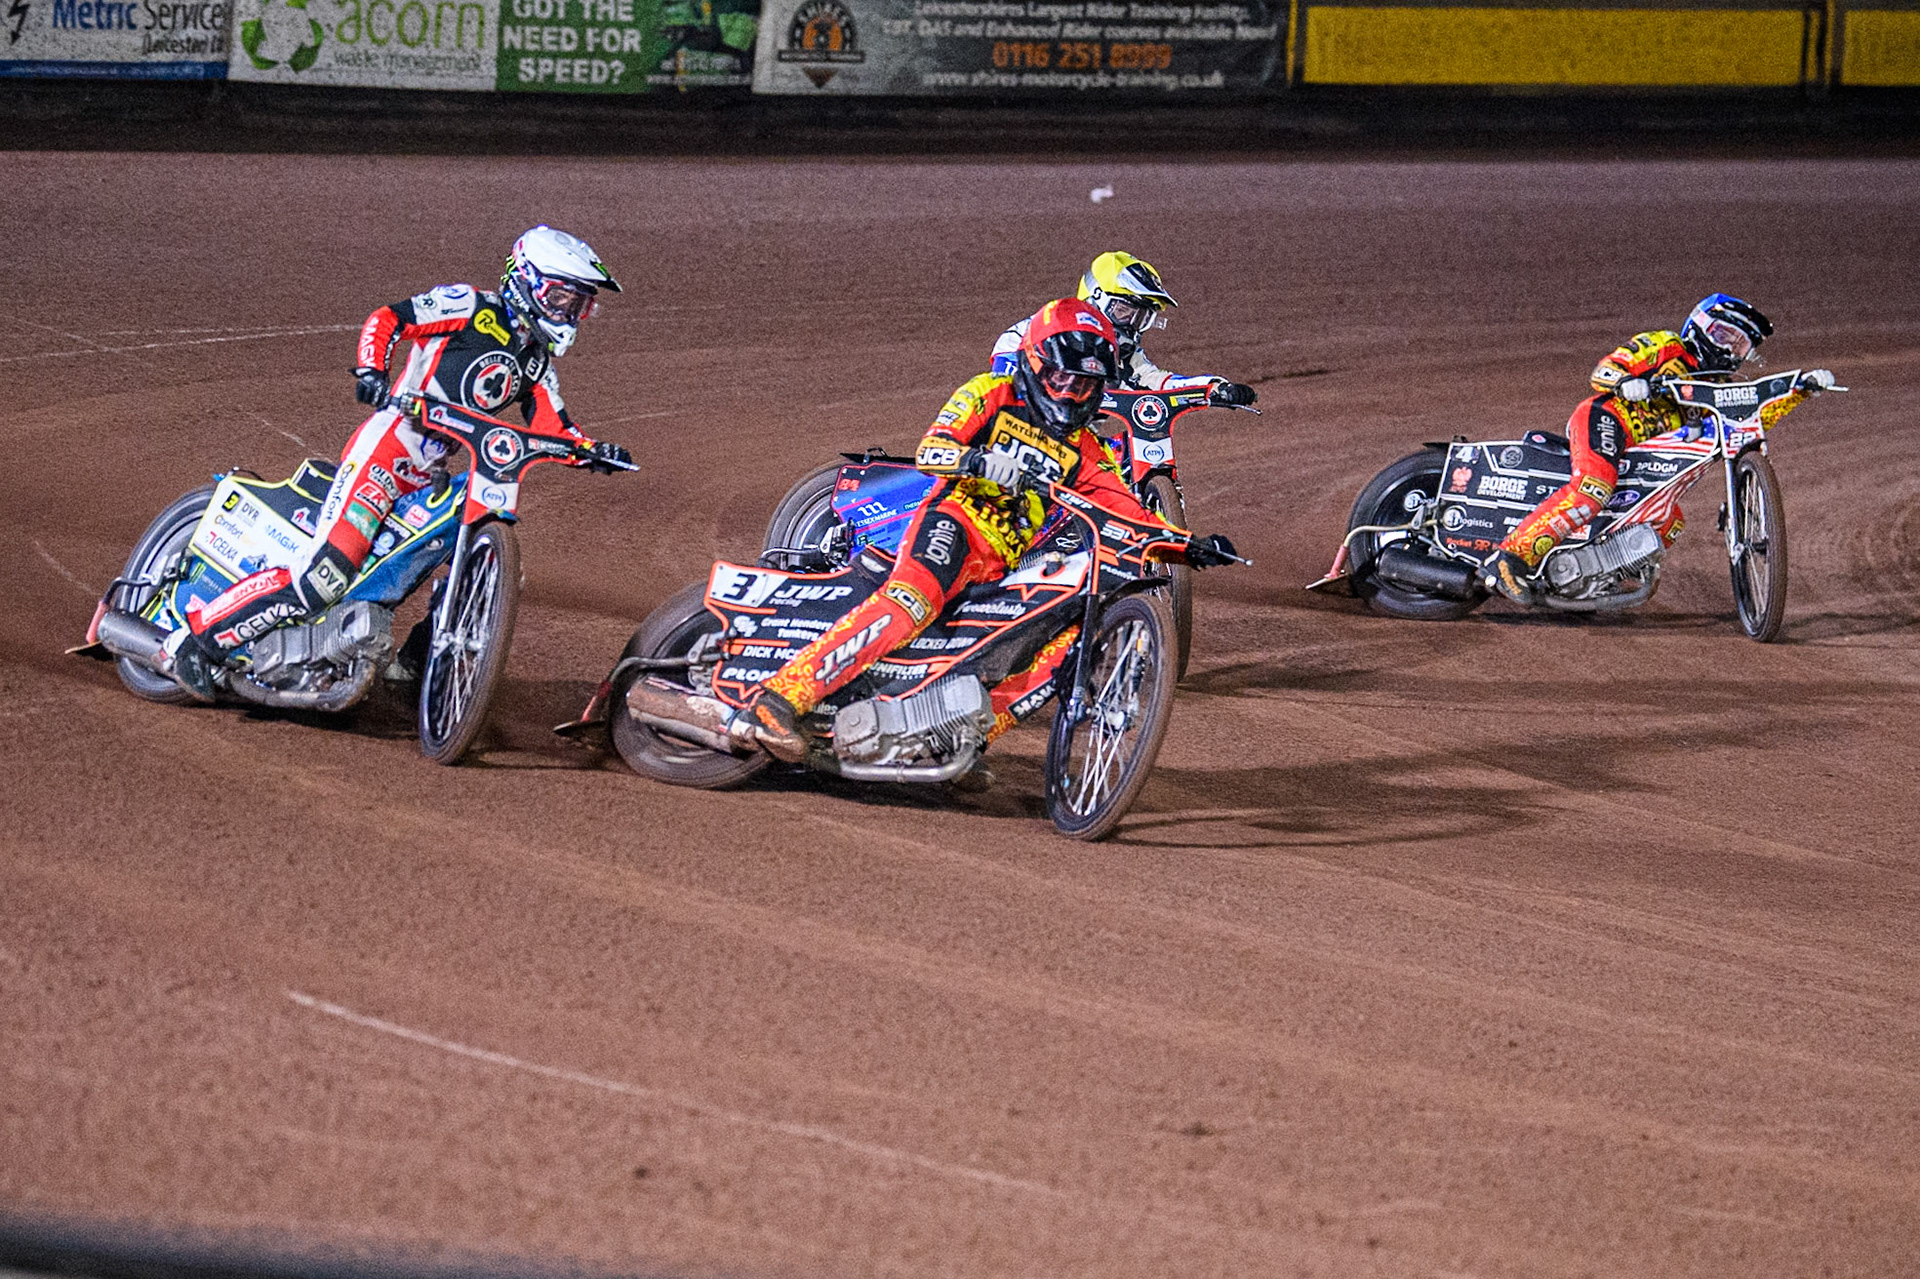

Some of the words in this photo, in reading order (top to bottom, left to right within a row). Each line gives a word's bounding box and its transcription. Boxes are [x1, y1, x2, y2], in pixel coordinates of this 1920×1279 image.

[53, 0, 137, 29] Metric
[513, 0, 571, 19] GOT
[580, 0, 635, 22] THE
[336, 2, 485, 48] acorn
[503, 26, 578, 51] NEED
[586, 27, 641, 52] FOR
[993, 43, 1050, 68] 0116
[1058, 43, 1102, 68] 251
[518, 58, 626, 85] SPEED?
[1714, 386, 1759, 402] BORGE
[1005, 417, 1048, 446] WATLING
[917, 448, 961, 466] JCB
[1455, 446, 1474, 463] 4
[326, 462, 356, 521] Comfort
[1476, 488, 1527, 501] DEVELOPMENT
[1479, 475, 1529, 494] BORGE
[224, 493, 240, 510] 3
[241, 502, 260, 521] DVR
[214, 514, 244, 539] Comfort
[213, 537, 239, 561] CELKA
[318, 566, 346, 594] DVR
[722, 572, 759, 601] 3
[768, 598, 804, 608] racing
[773, 585, 854, 601] JWP
[886, 587, 926, 621] JCB
[742, 645, 775, 659] DICK
[815, 613, 893, 681] JWP
